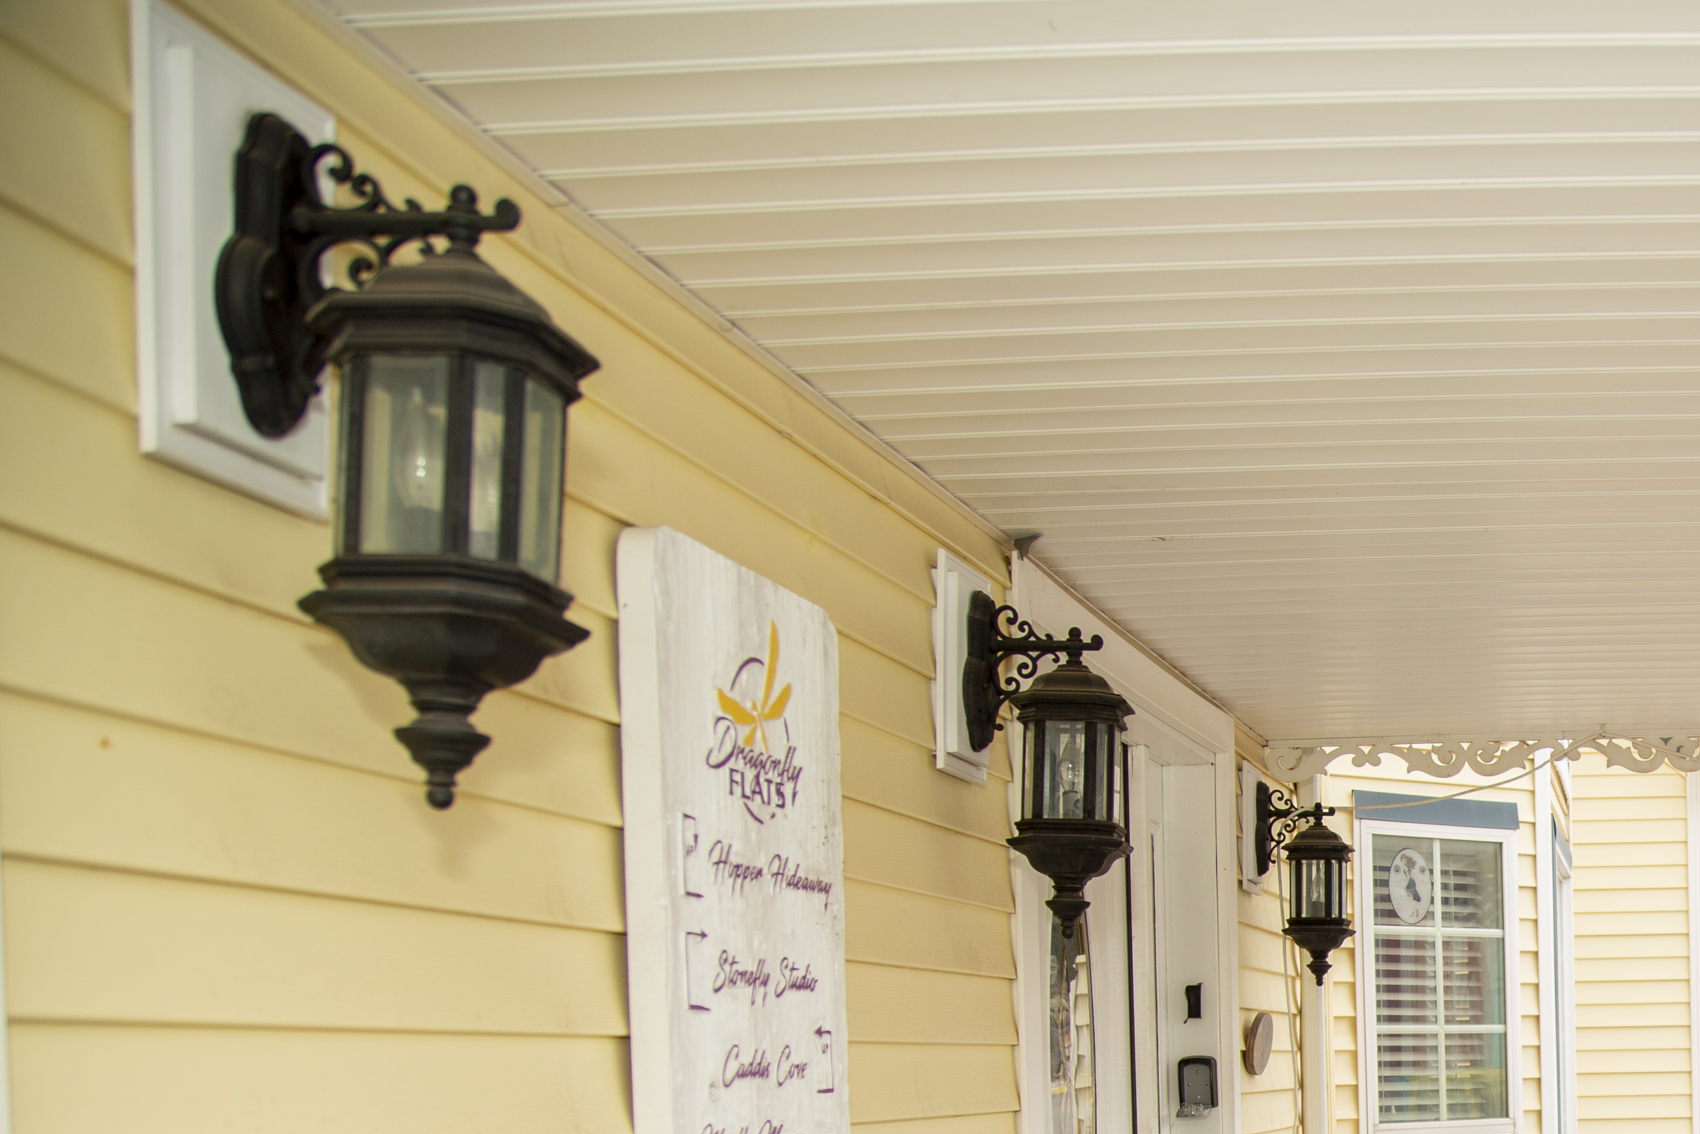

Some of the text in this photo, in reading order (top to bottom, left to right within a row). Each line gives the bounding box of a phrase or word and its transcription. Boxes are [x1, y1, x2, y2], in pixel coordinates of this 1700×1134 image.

[706, 717, 802, 807] Dragonfly
[729, 768, 786, 809] FLATS
[708, 840, 832, 911] Hopper Hideaway
[713, 949, 818, 1007] Stonefly Studio
[722, 1044, 807, 1088] Caddis Cove
